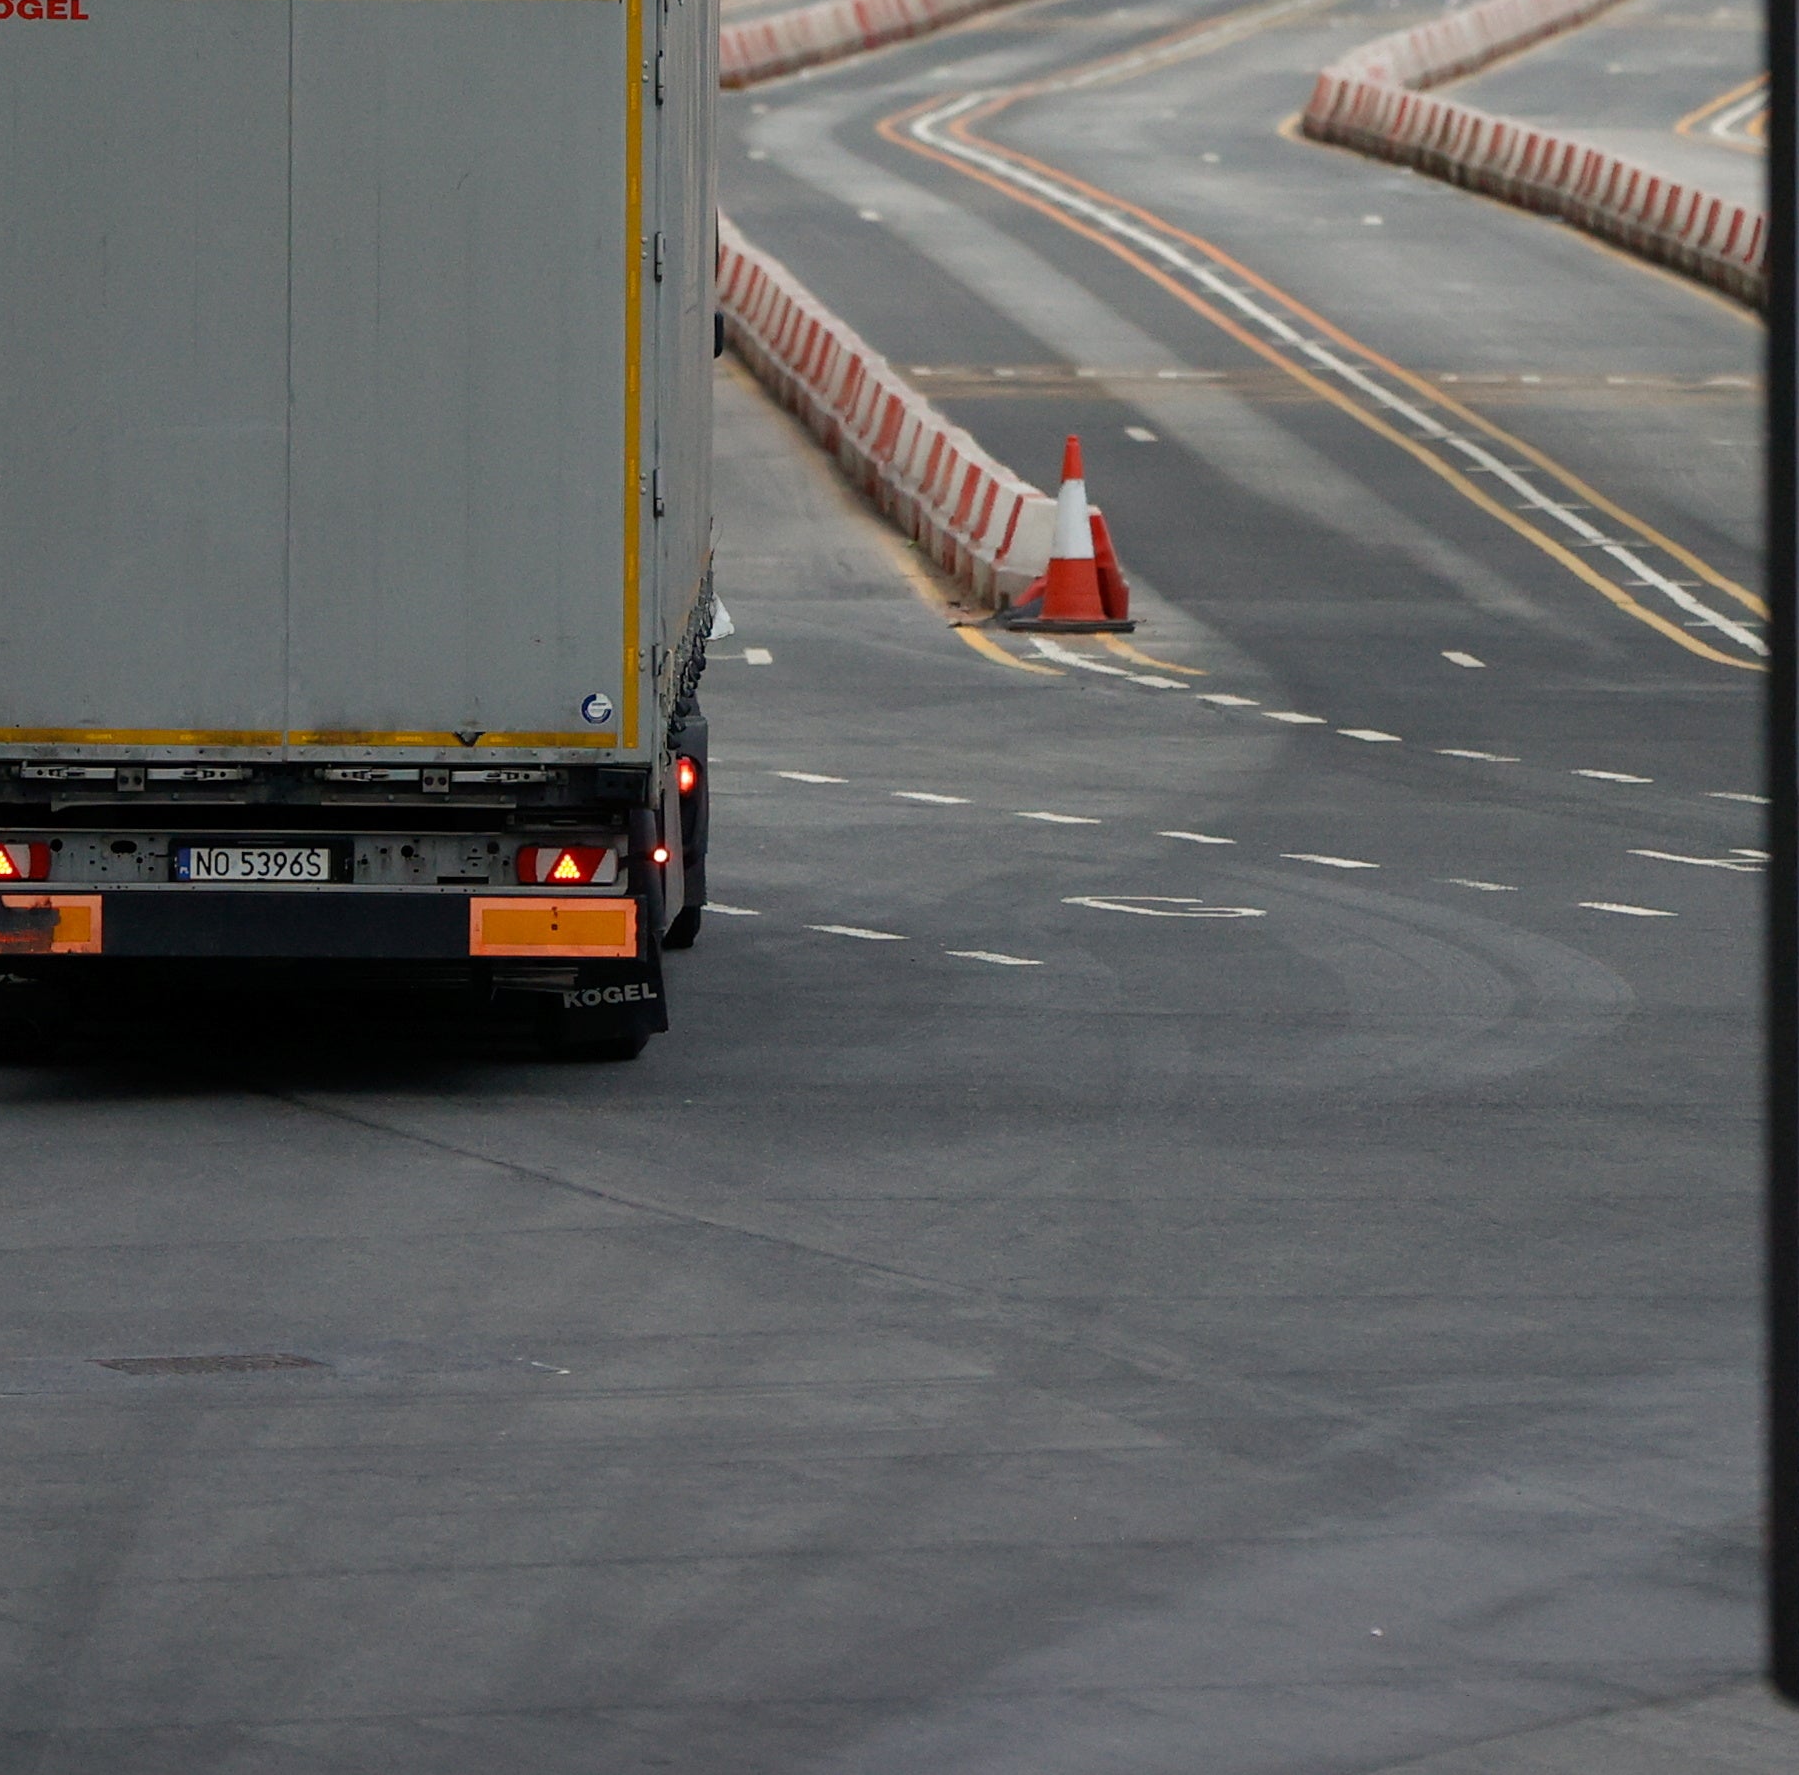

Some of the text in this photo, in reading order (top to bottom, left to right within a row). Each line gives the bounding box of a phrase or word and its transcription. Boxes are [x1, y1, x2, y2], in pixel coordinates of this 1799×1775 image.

[196, 850, 322, 877] NO 5396S
[562, 982, 658, 1009] KÖGEL
